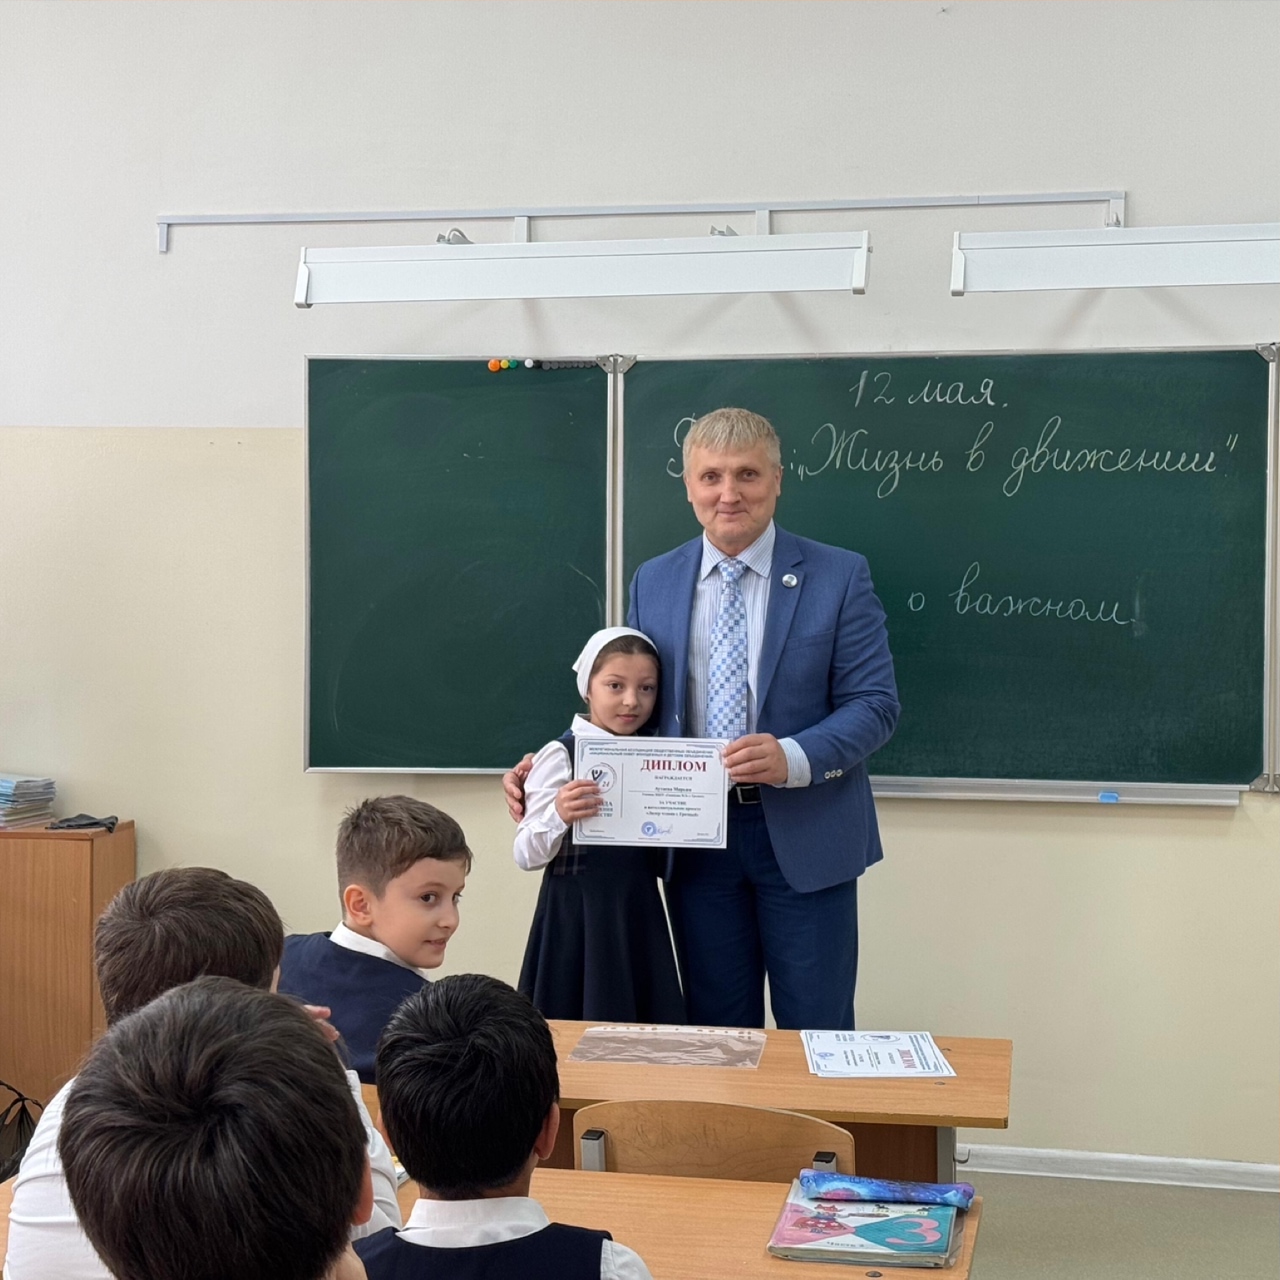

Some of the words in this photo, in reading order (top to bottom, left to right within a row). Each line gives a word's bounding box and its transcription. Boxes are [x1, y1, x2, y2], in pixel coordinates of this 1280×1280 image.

[849, 370, 895, 408] 12
[907, 378, 1009, 408] мая.
[965, 421, 995, 472] в
[907, 591, 925, 612] о
[640, 759, 707, 772] ДИПЛОМ
[885, 1217, 943, 1245] 3
